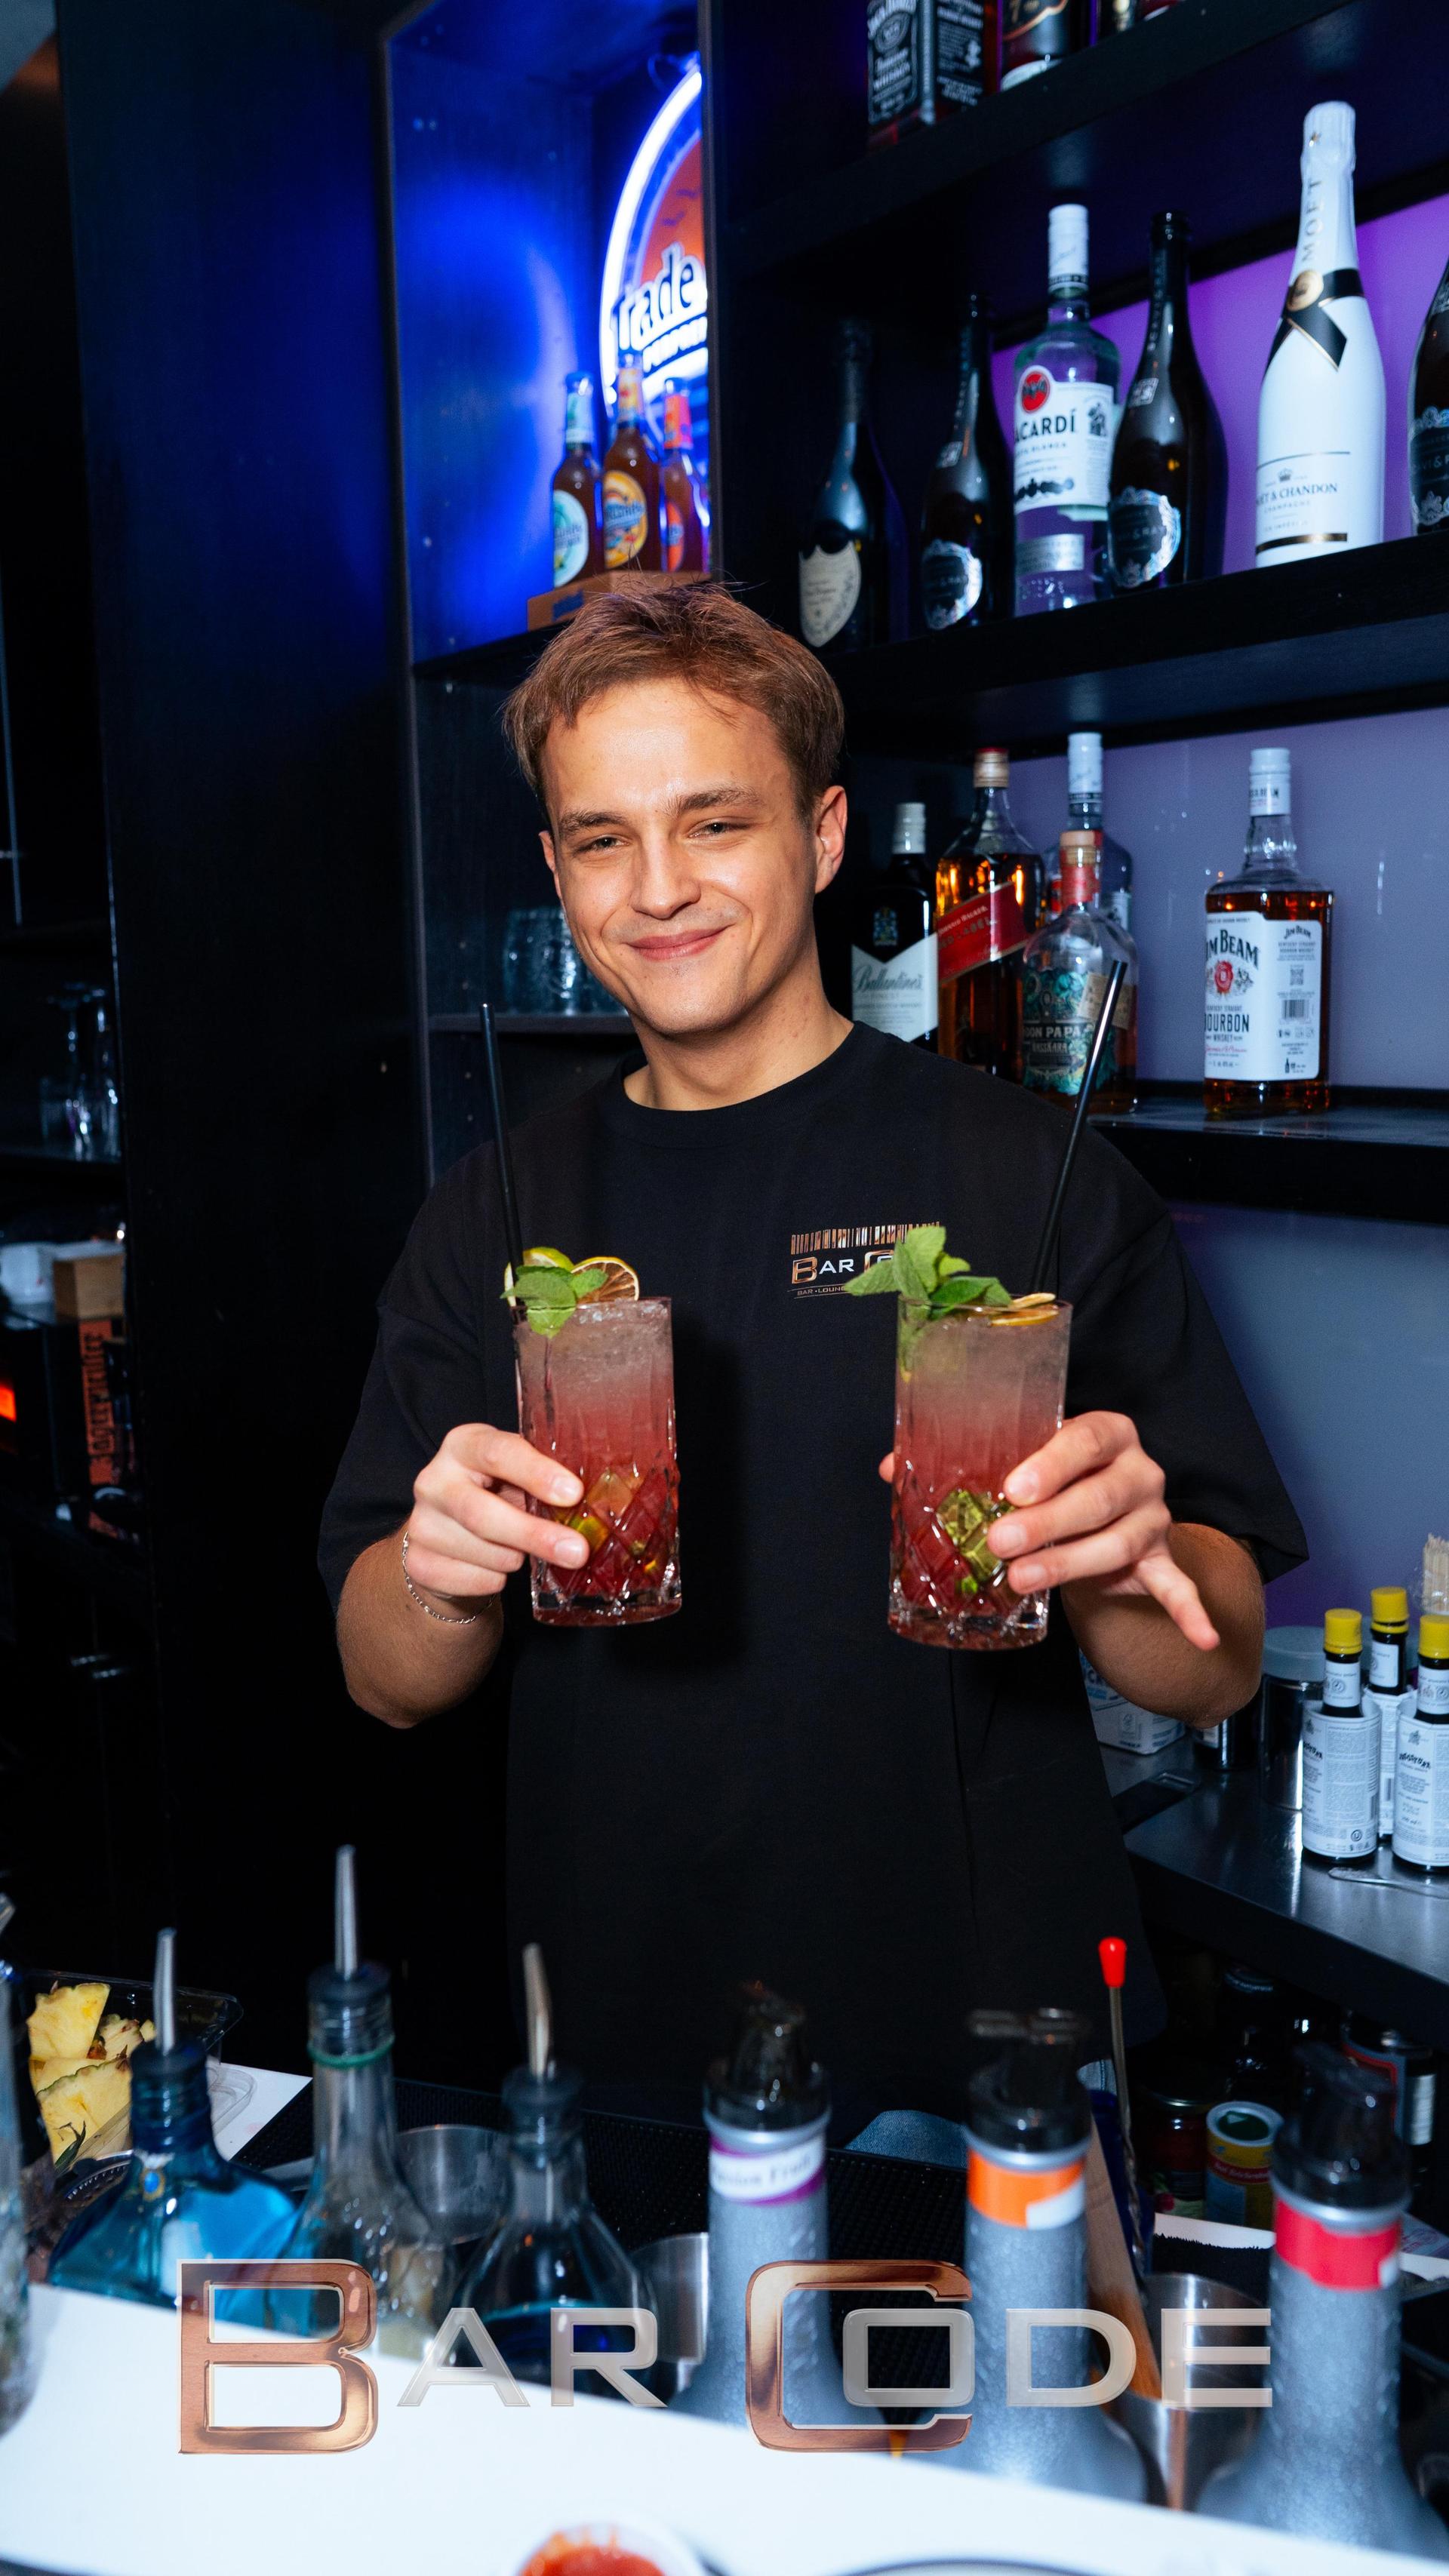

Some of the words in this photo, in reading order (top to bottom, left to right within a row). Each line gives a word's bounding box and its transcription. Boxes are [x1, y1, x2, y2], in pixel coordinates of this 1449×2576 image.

[1279, 482, 1338, 499] CHANDON
[1205, 936, 1218, 961] IM
[1220, 929, 1260, 970] BEAM
[792, 1256, 855, 1284] BAR
